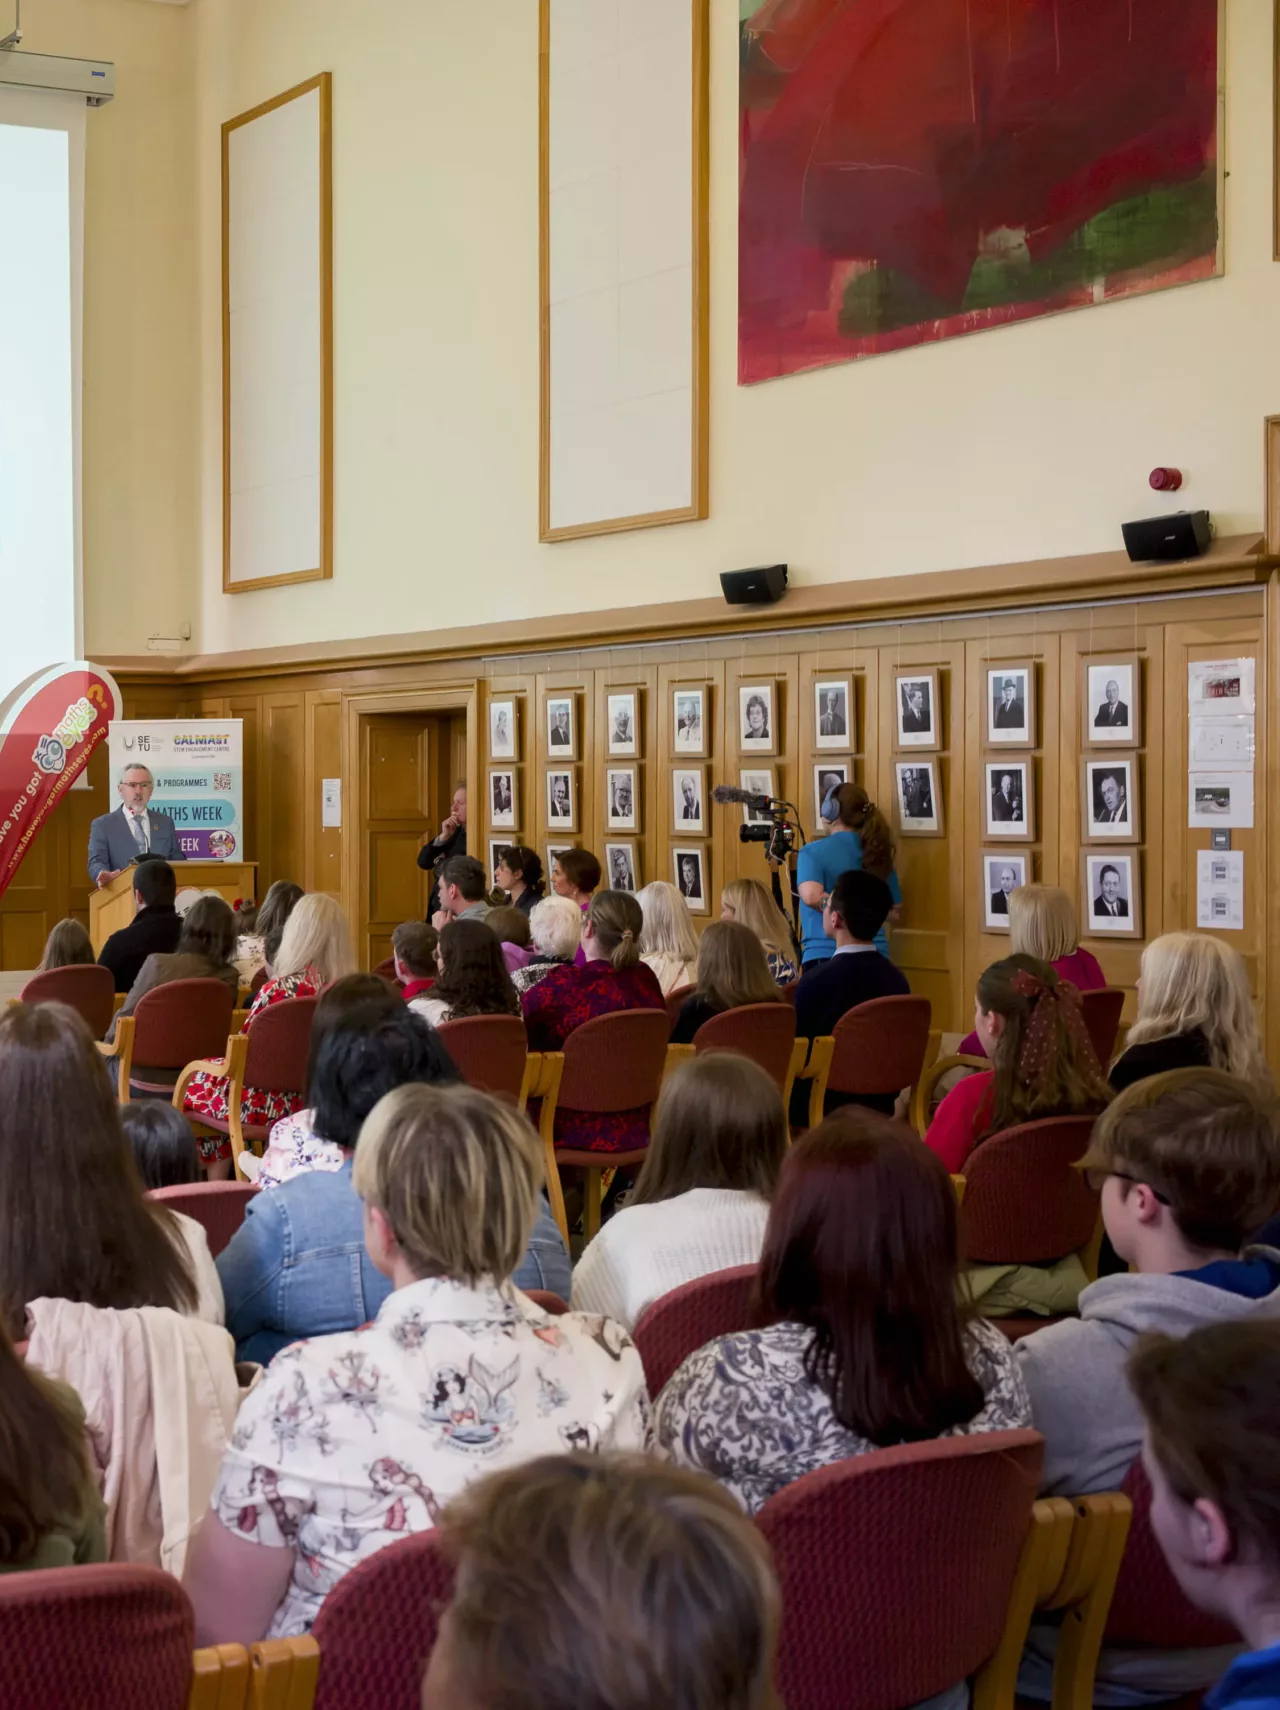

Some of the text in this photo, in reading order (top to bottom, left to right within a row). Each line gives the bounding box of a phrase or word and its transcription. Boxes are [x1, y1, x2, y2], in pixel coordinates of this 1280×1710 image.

[55, 699, 89, 740] maths
[62, 705, 98, 750] eyes
[173, 734, 230, 746] CALMAST
[163, 778, 208, 787] PROGRAMMES
[8, 795, 28, 824] you
[25, 769, 44, 798] got
[191, 806, 223, 821] WEEK
[179, 837, 200, 851] EEK
